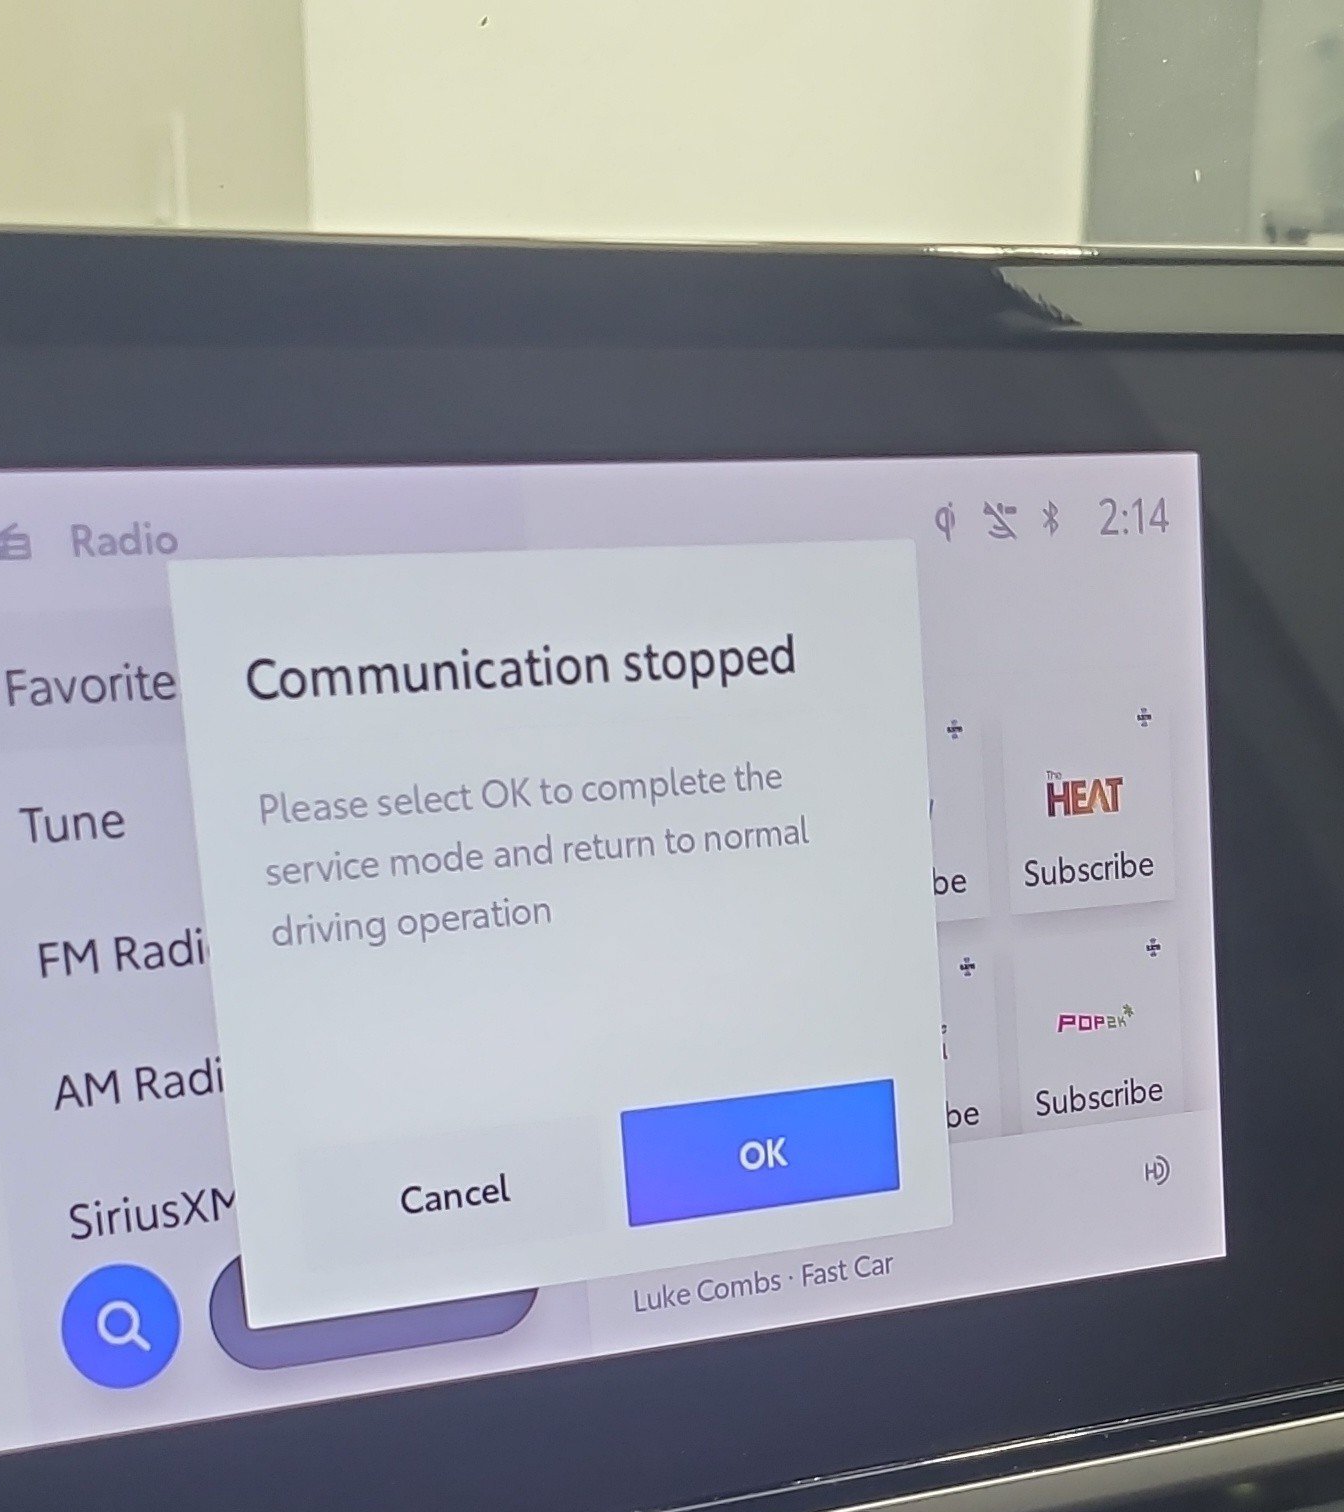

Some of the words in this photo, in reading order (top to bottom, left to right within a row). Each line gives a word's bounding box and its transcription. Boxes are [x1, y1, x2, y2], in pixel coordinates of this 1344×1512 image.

[1099, 497, 1169, 536] 2:14
[71, 521, 178, 559] Radio
[246, 644, 610, 701] Communication
[624, 634, 796, 690] stopped
[259, 793, 368, 826] Please
[377, 781, 472, 819] select
[481, 777, 532, 811] OK
[540, 779, 573, 806] to
[581, 767, 726, 807] complete
[733, 761, 783, 792] the
[1046, 777, 1123, 817] HEAT
[19, 805, 126, 845] Tune
[266, 852, 380, 887] service
[389, 840, 484, 877] mode
[493, 835, 553, 870] and
[562, 833, 655, 865] return
[664, 829, 695, 856] to
[703, 816, 810, 852] normal
[1024, 850, 1154, 887] Subscribe
[271, 910, 388, 949] driving
[396, 898, 551, 943] operation
[38, 939, 99, 979] FM
[116, 927, 210, 973] Radi
[55, 1070, 121, 1111] AM
[1036, 1078, 1164, 1117] Subscribe
[739, 1137, 788, 1172] OK
[400, 1173, 511, 1214] Cancel
[633, 1284, 691, 1313] Luke
[696, 1268, 781, 1304] Combs
[801, 1257, 848, 1288] Fast
[853, 1252, 895, 1279] Car
